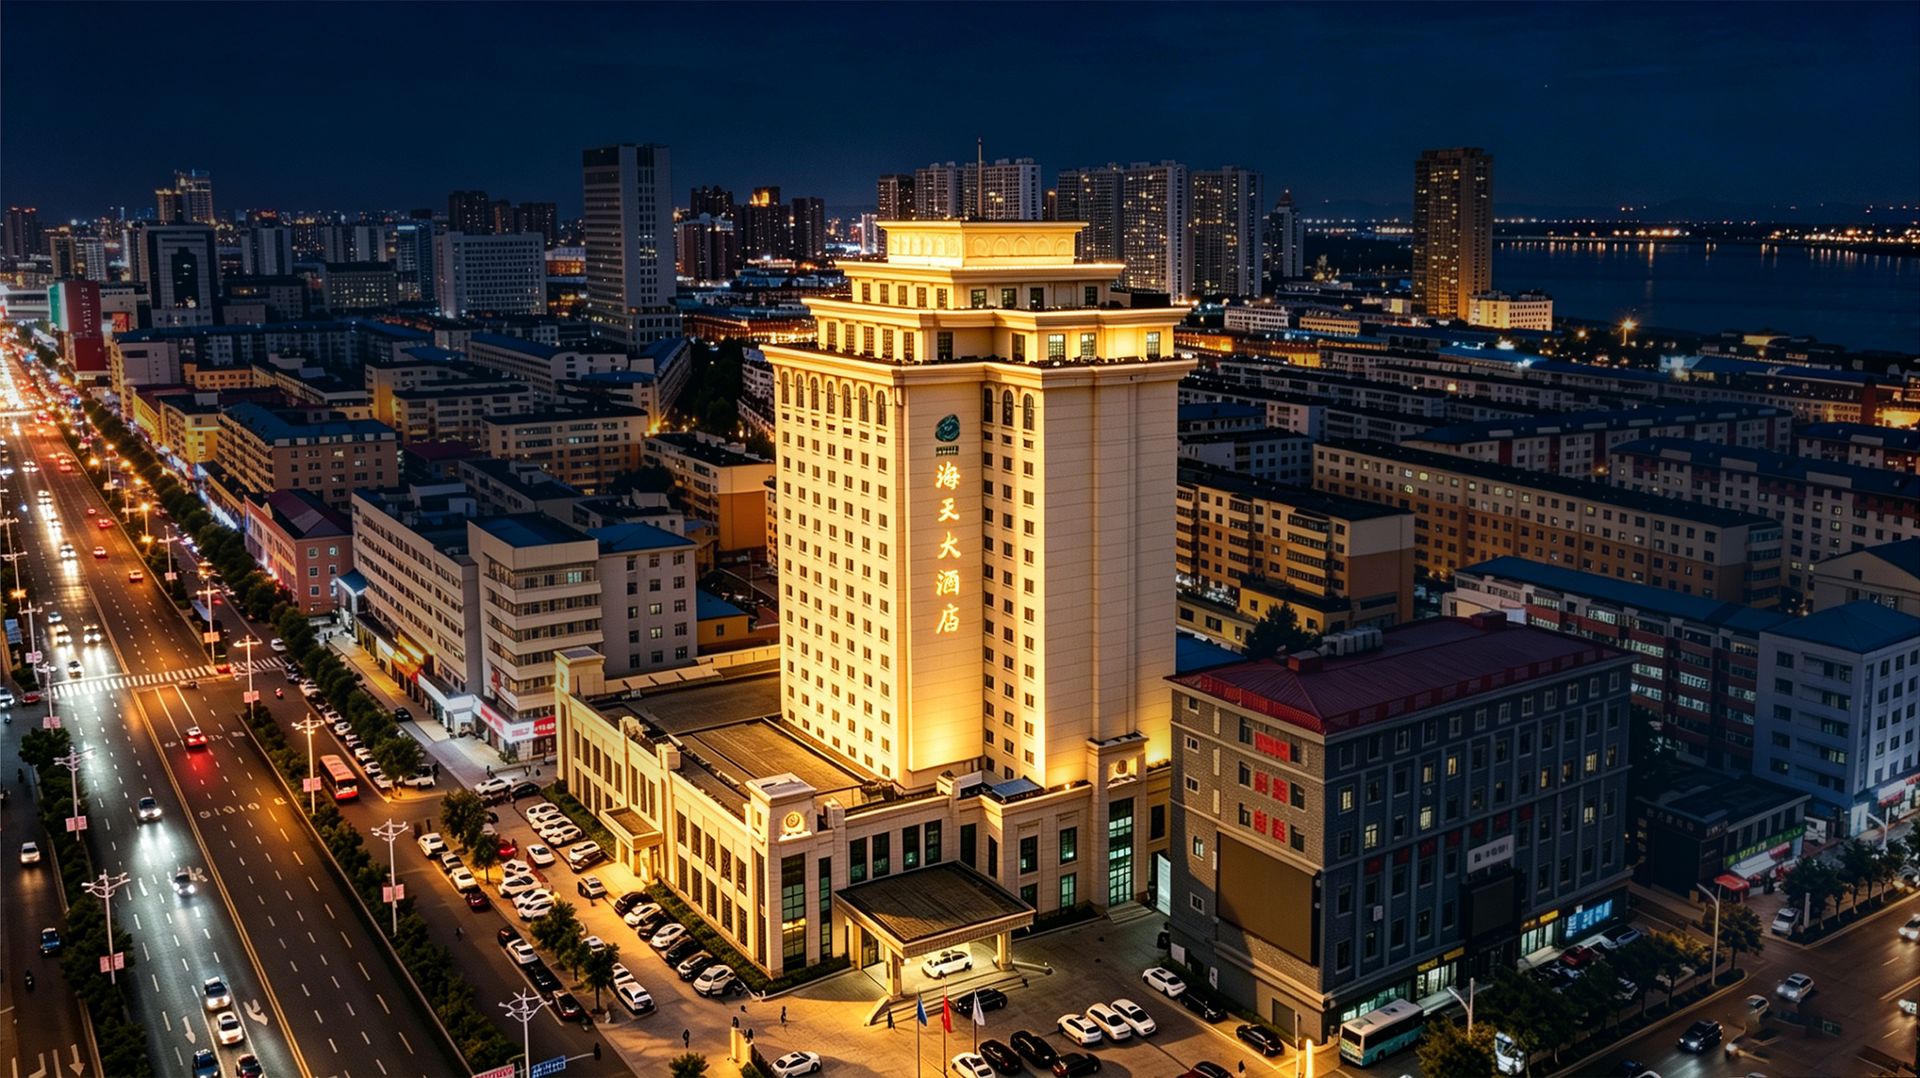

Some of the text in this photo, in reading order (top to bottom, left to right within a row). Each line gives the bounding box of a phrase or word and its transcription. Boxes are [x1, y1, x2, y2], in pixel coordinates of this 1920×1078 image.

[935, 461, 961, 635] 海天大酒店
